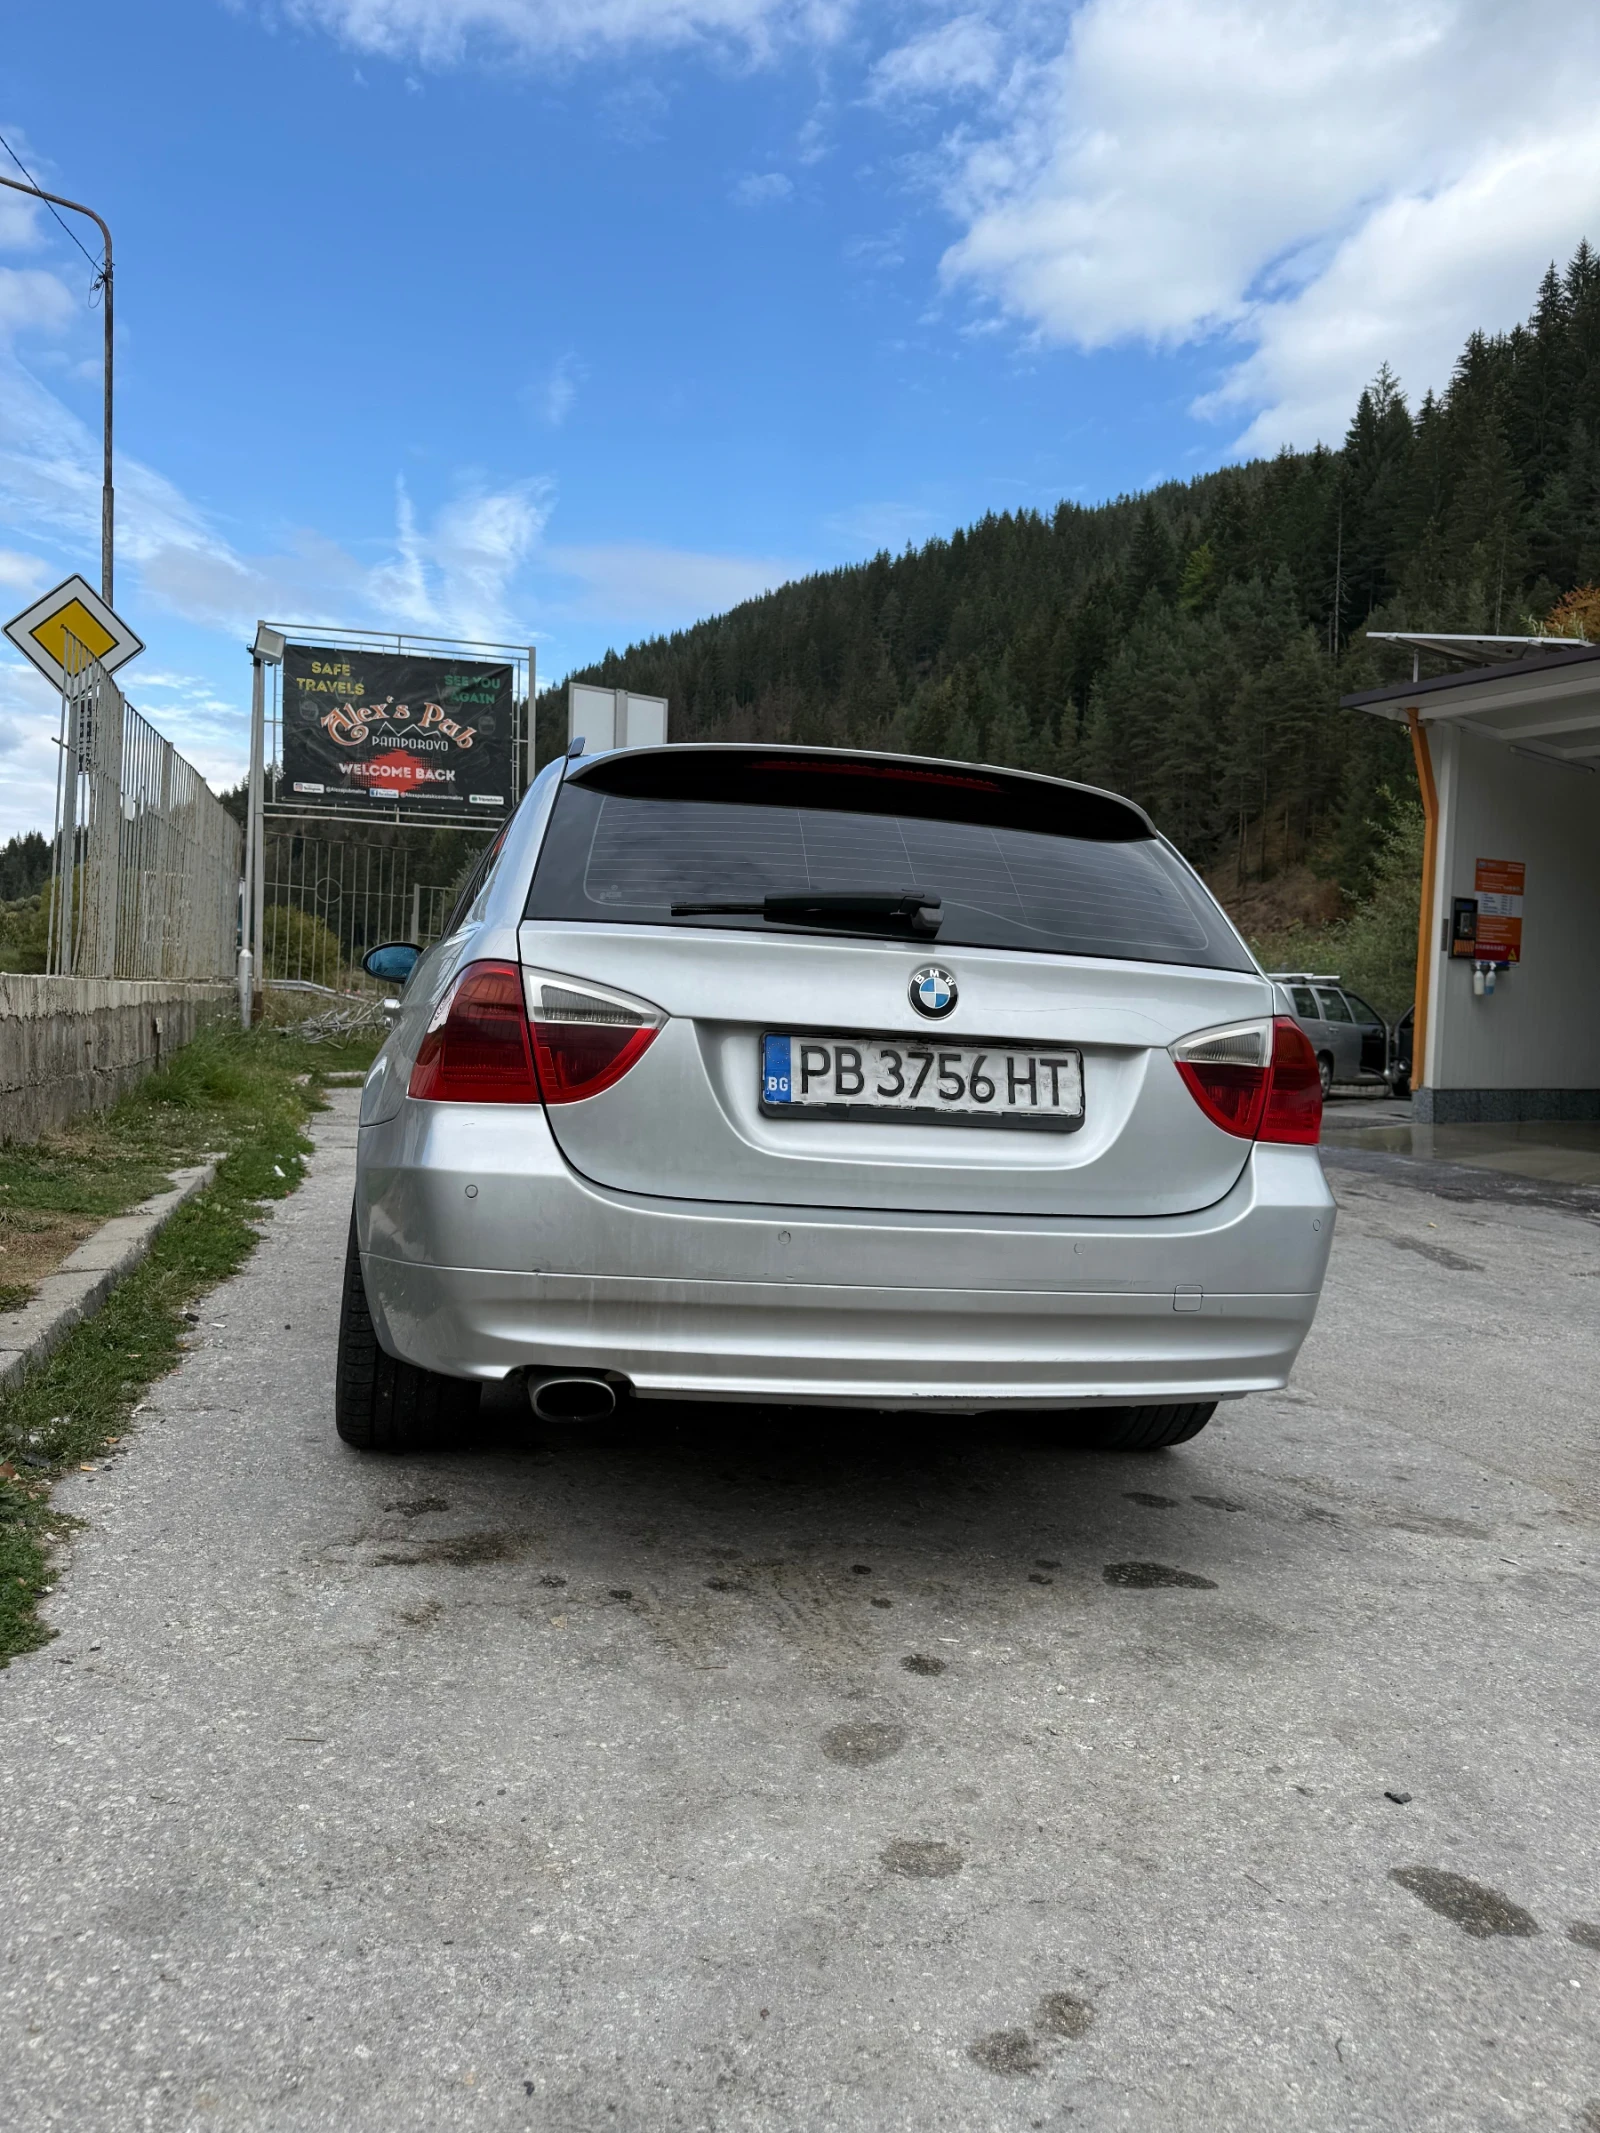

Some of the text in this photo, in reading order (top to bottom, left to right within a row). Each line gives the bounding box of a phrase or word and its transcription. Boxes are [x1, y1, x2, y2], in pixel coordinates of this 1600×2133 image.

[311, 662, 351, 677] SAFE
[296, 678, 365, 695] TRAVELS
[444, 675, 500, 689] SEE YOU
[451, 693, 495, 704] AGAIN
[320, 695, 477, 749] Alex's Pub
[372, 736, 449, 752] PAMPOROVO
[339, 763, 456, 781] WELCOME BACK
[914, 969, 955, 986] BMW
[768, 1077, 788, 1091] BG
[800, 1045, 1069, 1107] PB 3756 HT
